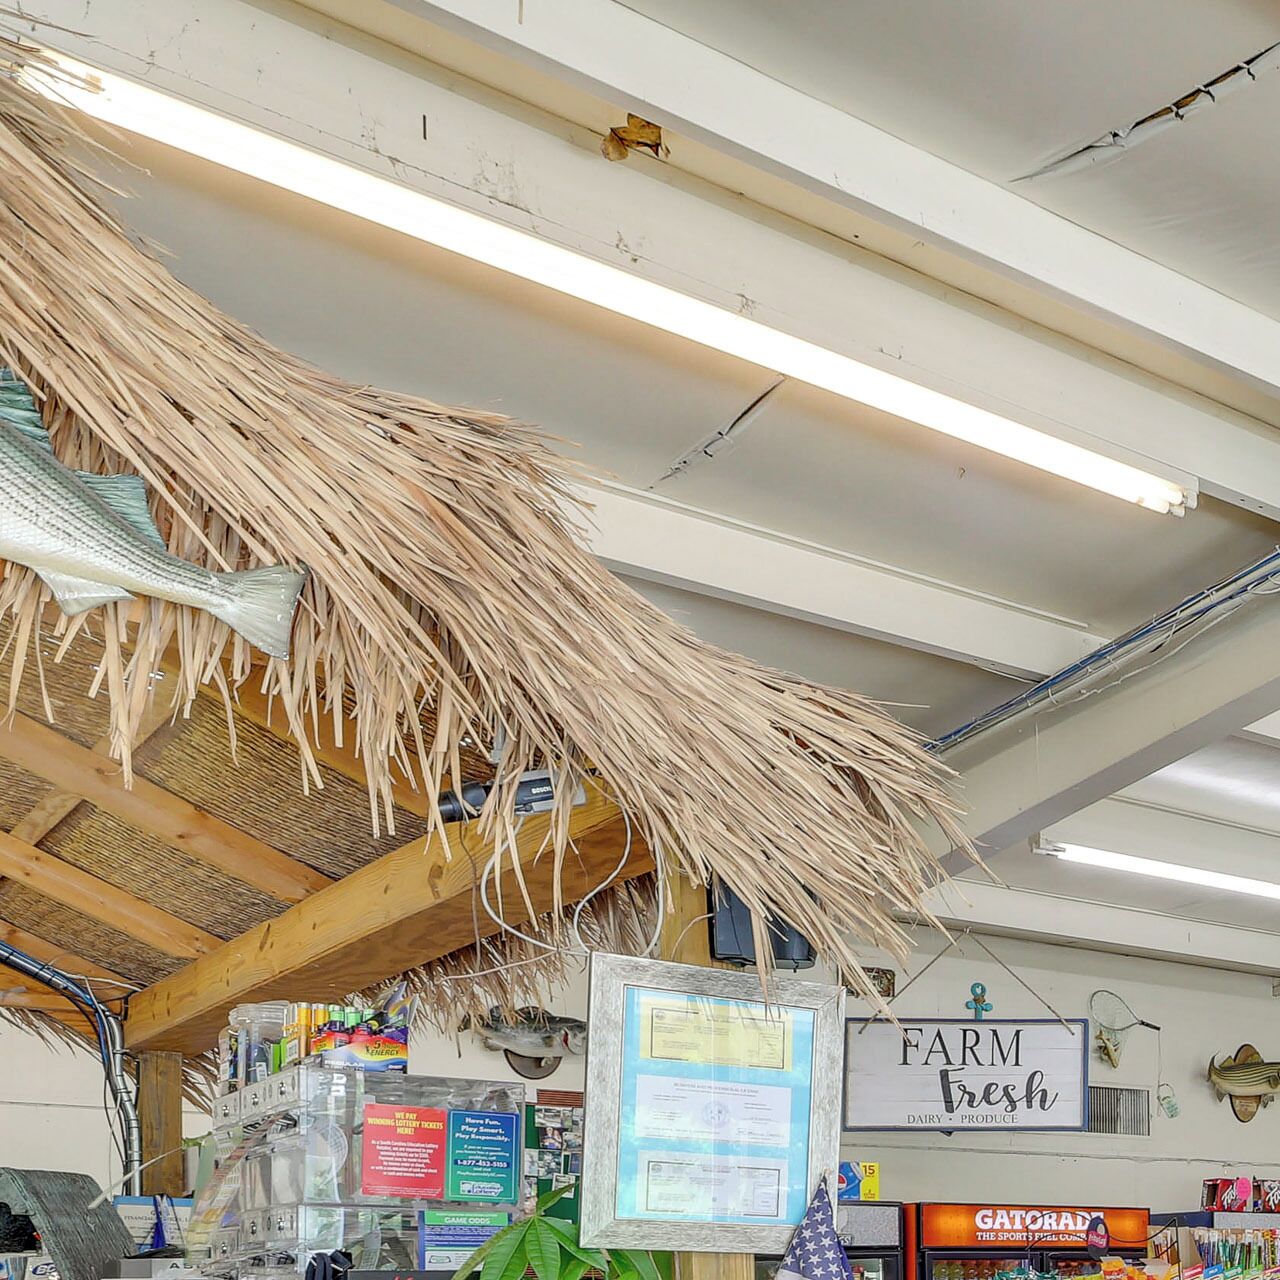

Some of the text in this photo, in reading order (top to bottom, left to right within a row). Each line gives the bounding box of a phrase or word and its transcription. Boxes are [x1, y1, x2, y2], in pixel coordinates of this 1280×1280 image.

[897, 1027, 1023, 1066] FARM
[940, 1067, 1058, 1113] Fresh
[368, 1117, 443, 1129] WINNING LOTTERY TICKETS
[465, 1117, 483, 1125] Have
[907, 1114, 1019, 1124] DAIRY PRODUCE
[461, 1125, 478, 1133] Play
[455, 1133, 470, 1141] Play
[863, 1165, 875, 1175] 15
[444, 1216, 468, 1224] GAME
[976, 1232, 1088, 1241] THE SPORTS FUEL COMP
